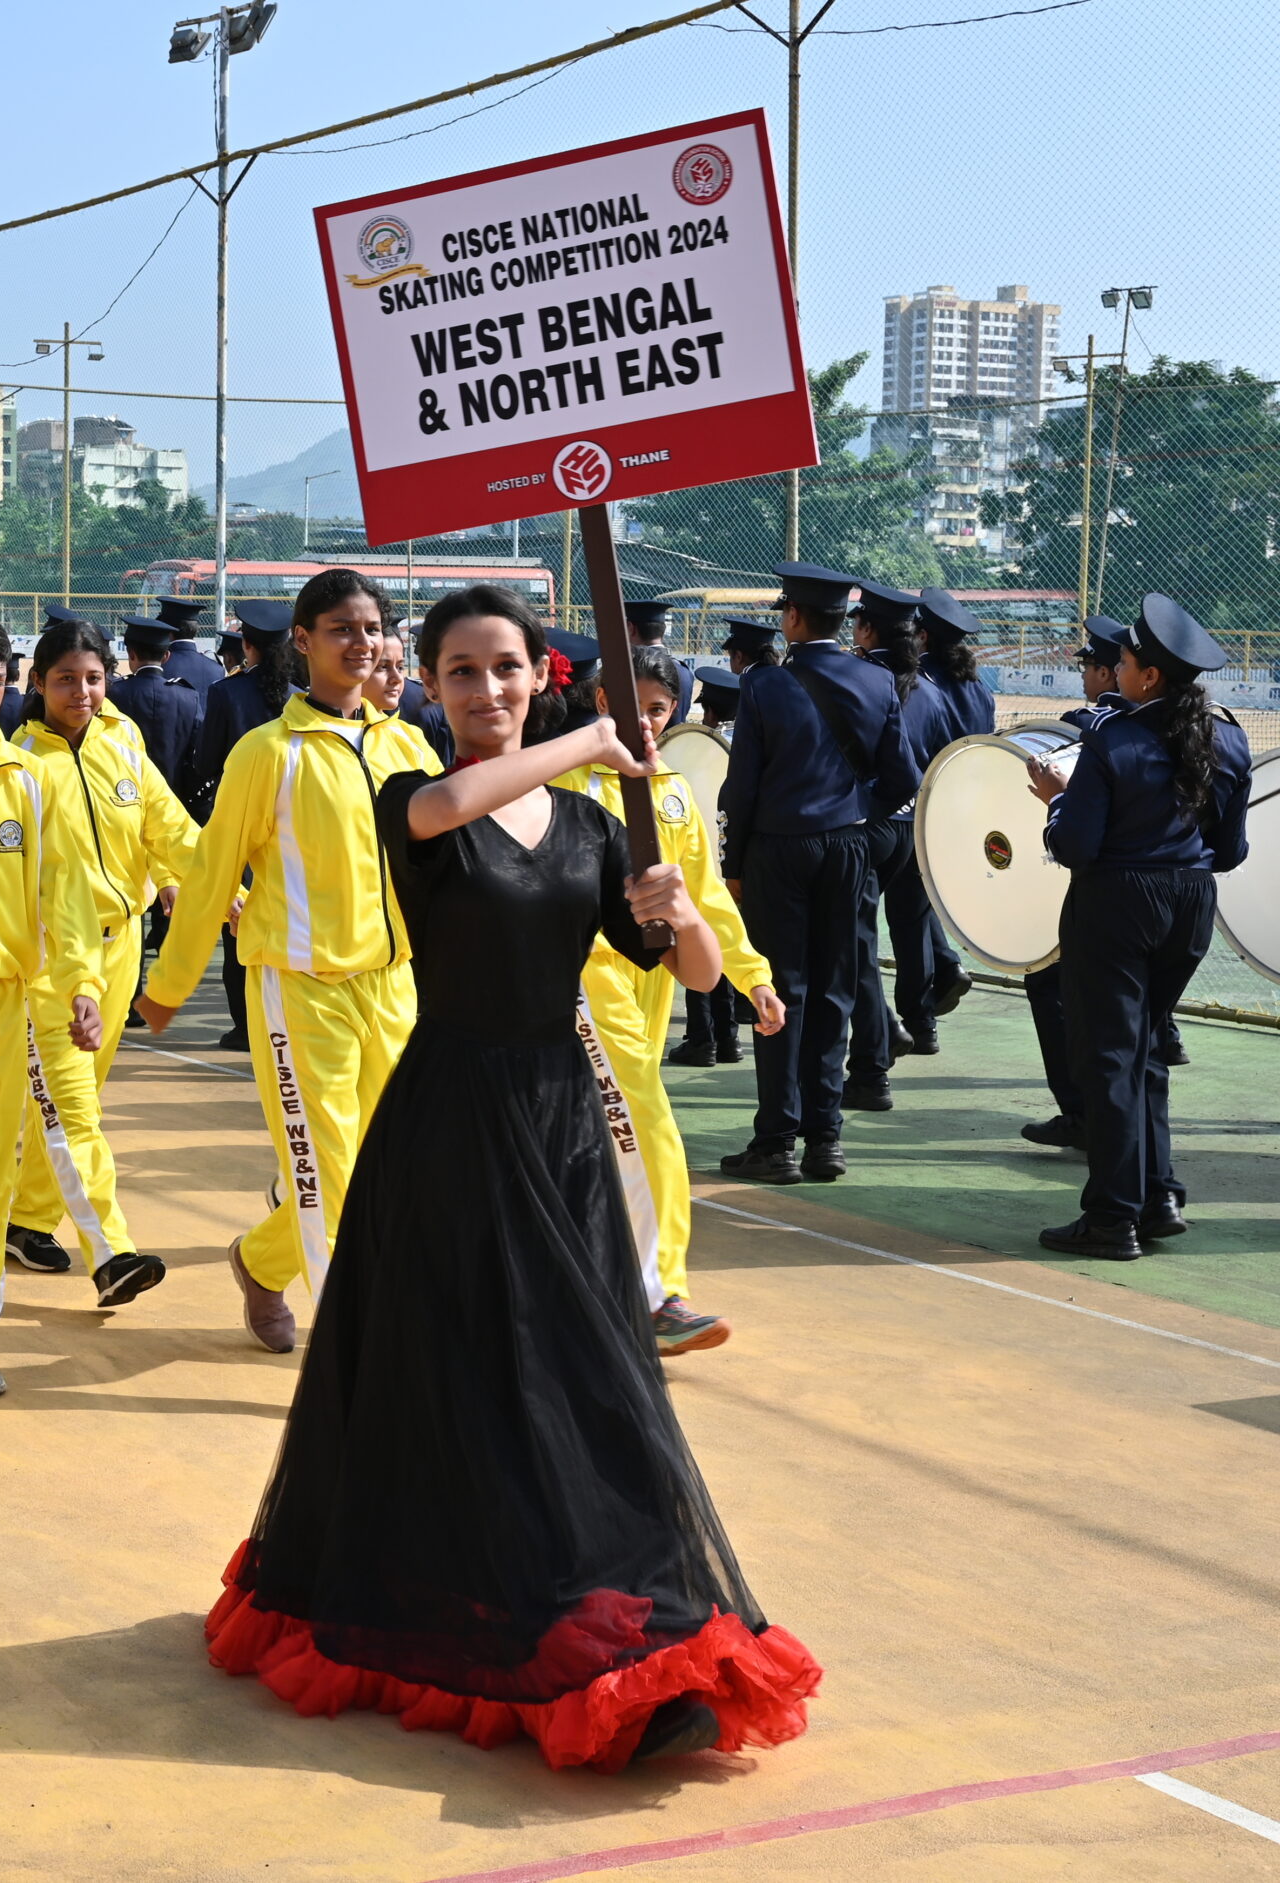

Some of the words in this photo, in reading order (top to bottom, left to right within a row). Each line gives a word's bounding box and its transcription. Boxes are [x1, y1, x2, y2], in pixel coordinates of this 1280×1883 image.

[379, 267, 484, 314] SKATING
[490, 229, 662, 291] COMPETITION
[668, 215, 729, 255] 2024
[442, 220, 516, 262] CISCE
[521, 193, 649, 246] NATIONAL
[411, 312, 525, 377] WEST
[539, 277, 712, 352] BENGAL
[419, 389, 450, 435] &
[458, 357, 605, 427] NORTH
[616, 332, 723, 396] EAST
[487, 475, 529, 492] HOSTED
[532, 473, 546, 485] BY
[619, 450, 670, 468] THANE
[269, 1032, 301, 1115] CISCE
[285, 1125, 318, 1209] WB&NE
[596, 1076, 636, 1154] WB&NE
